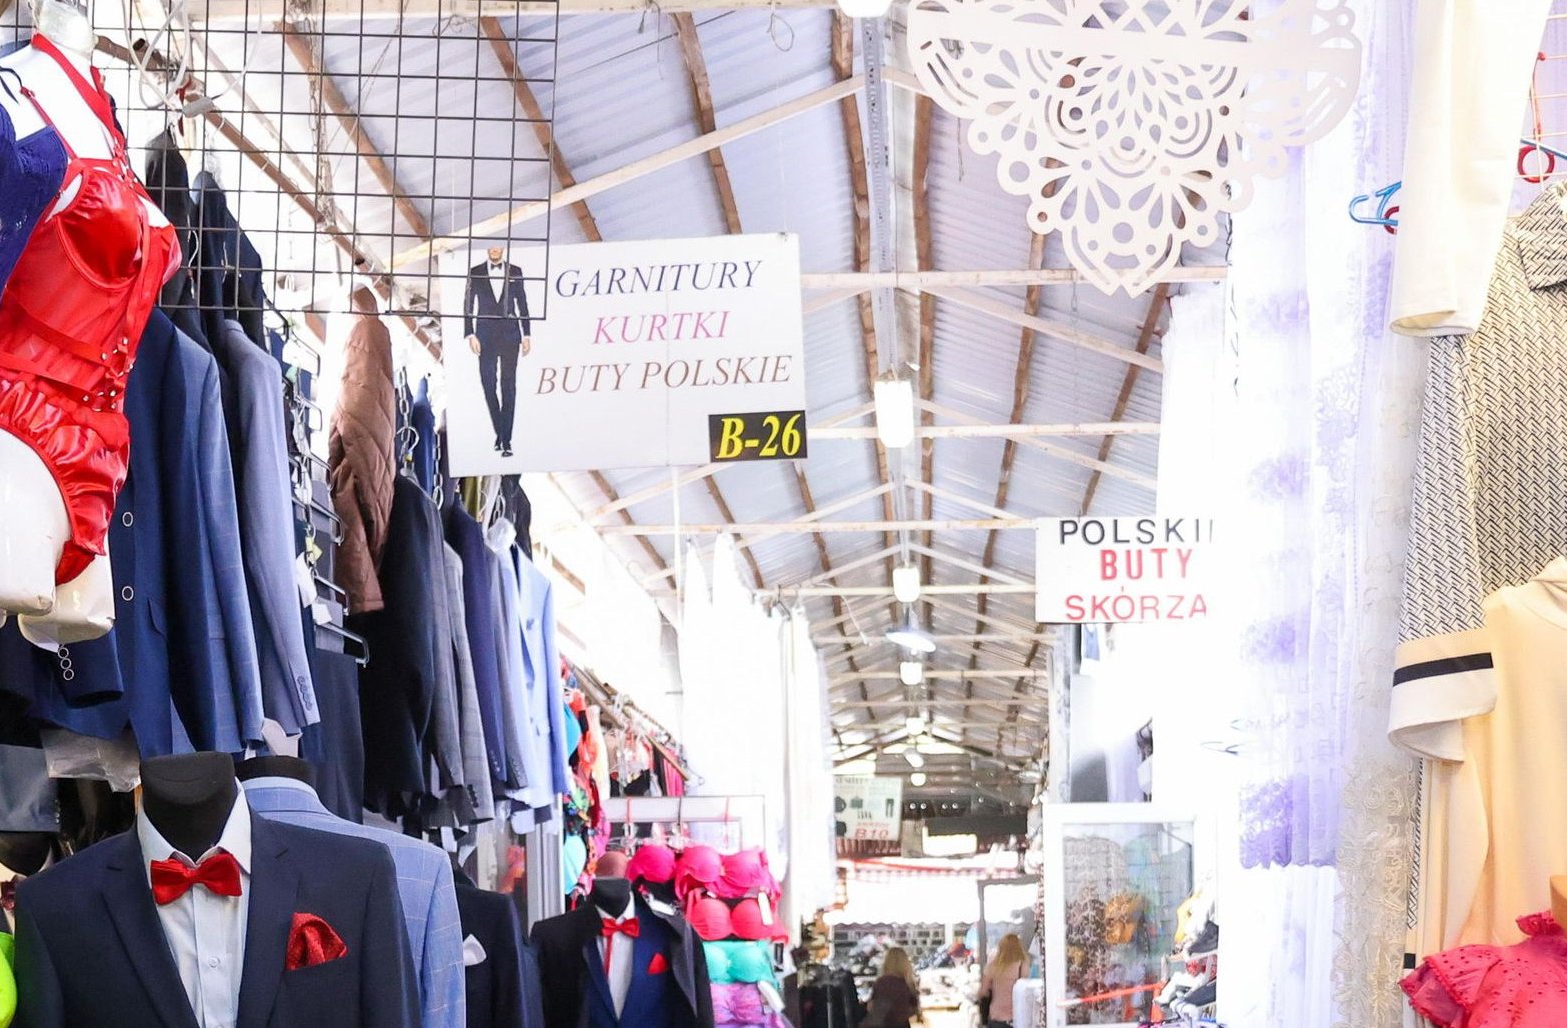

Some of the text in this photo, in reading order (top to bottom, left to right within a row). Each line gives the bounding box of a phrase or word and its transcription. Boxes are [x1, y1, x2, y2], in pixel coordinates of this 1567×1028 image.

[554, 259, 764, 299] GARNITURY
[592, 310, 731, 345] KURTKI
[536, 354, 794, 396] BUTY POLSKIE
[717, 413, 802, 460] B-26
[1059, 518, 1214, 546] POLSKI
[1099, 548, 1193, 581] BUTY
